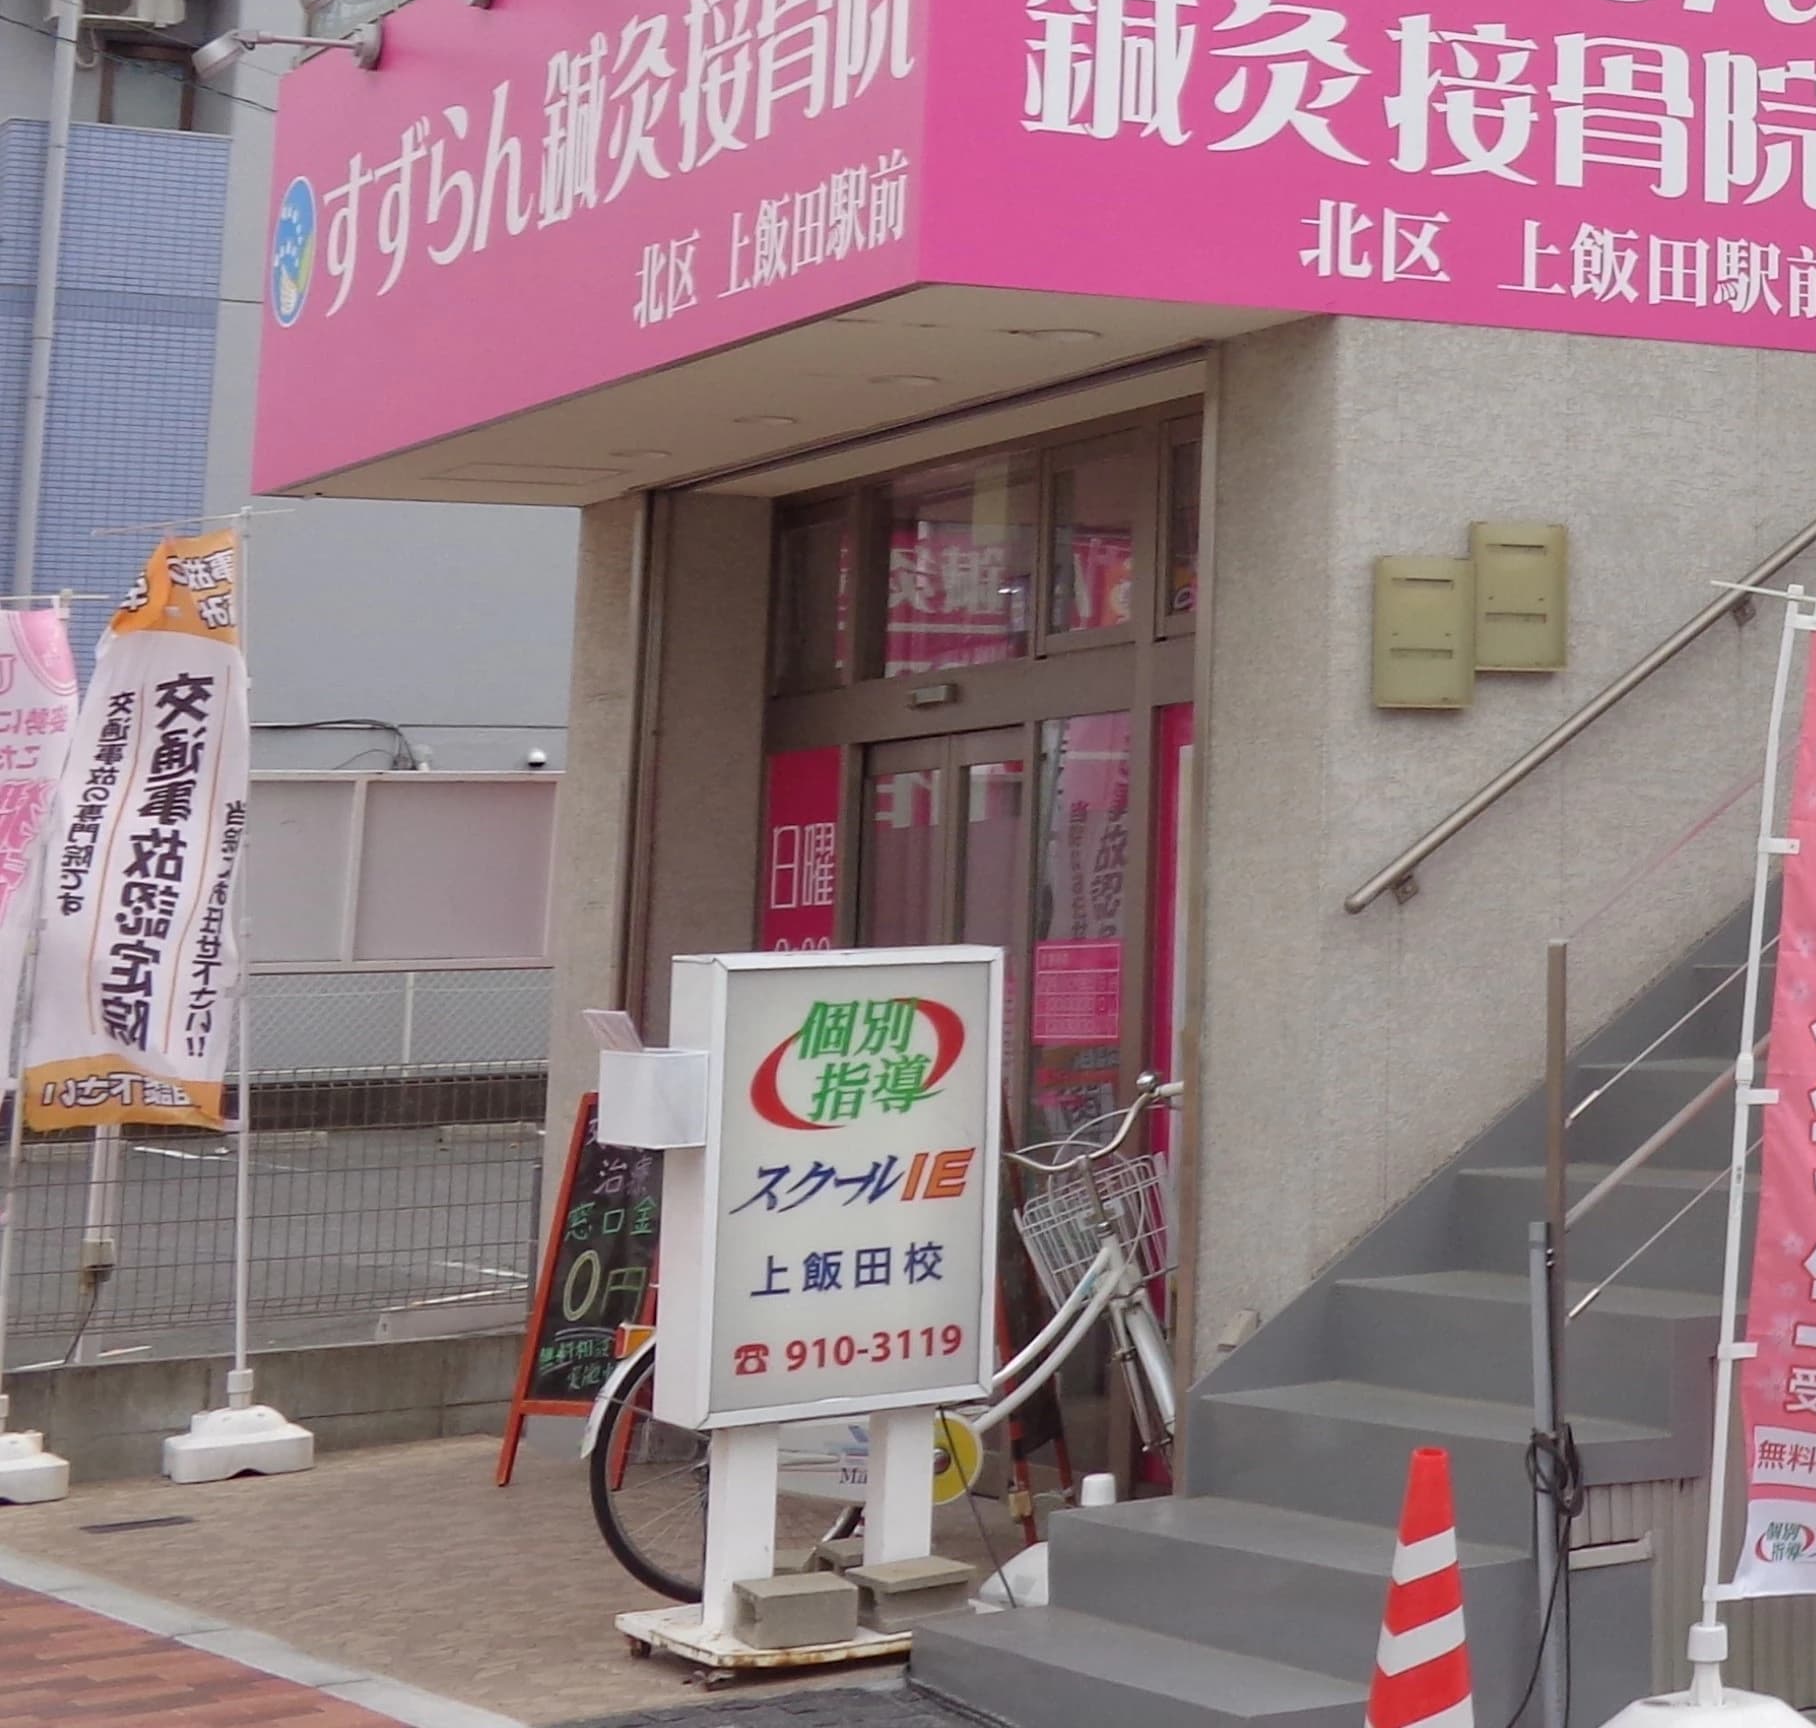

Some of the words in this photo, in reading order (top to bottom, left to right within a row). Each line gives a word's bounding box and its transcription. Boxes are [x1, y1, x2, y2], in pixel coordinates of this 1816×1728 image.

[633, 228, 698, 328] 北区
[717, 148, 911, 299] 上飯田駅前
[1300, 200, 1450, 284] 北区
[770, 822, 836, 909] 日曜
[796, 997, 919, 1061] 個別
[811, 1055, 947, 1123] 指導
[730, 1147, 975, 1214] スクールIE
[750, 1242, 944, 1298] 上飯田校
